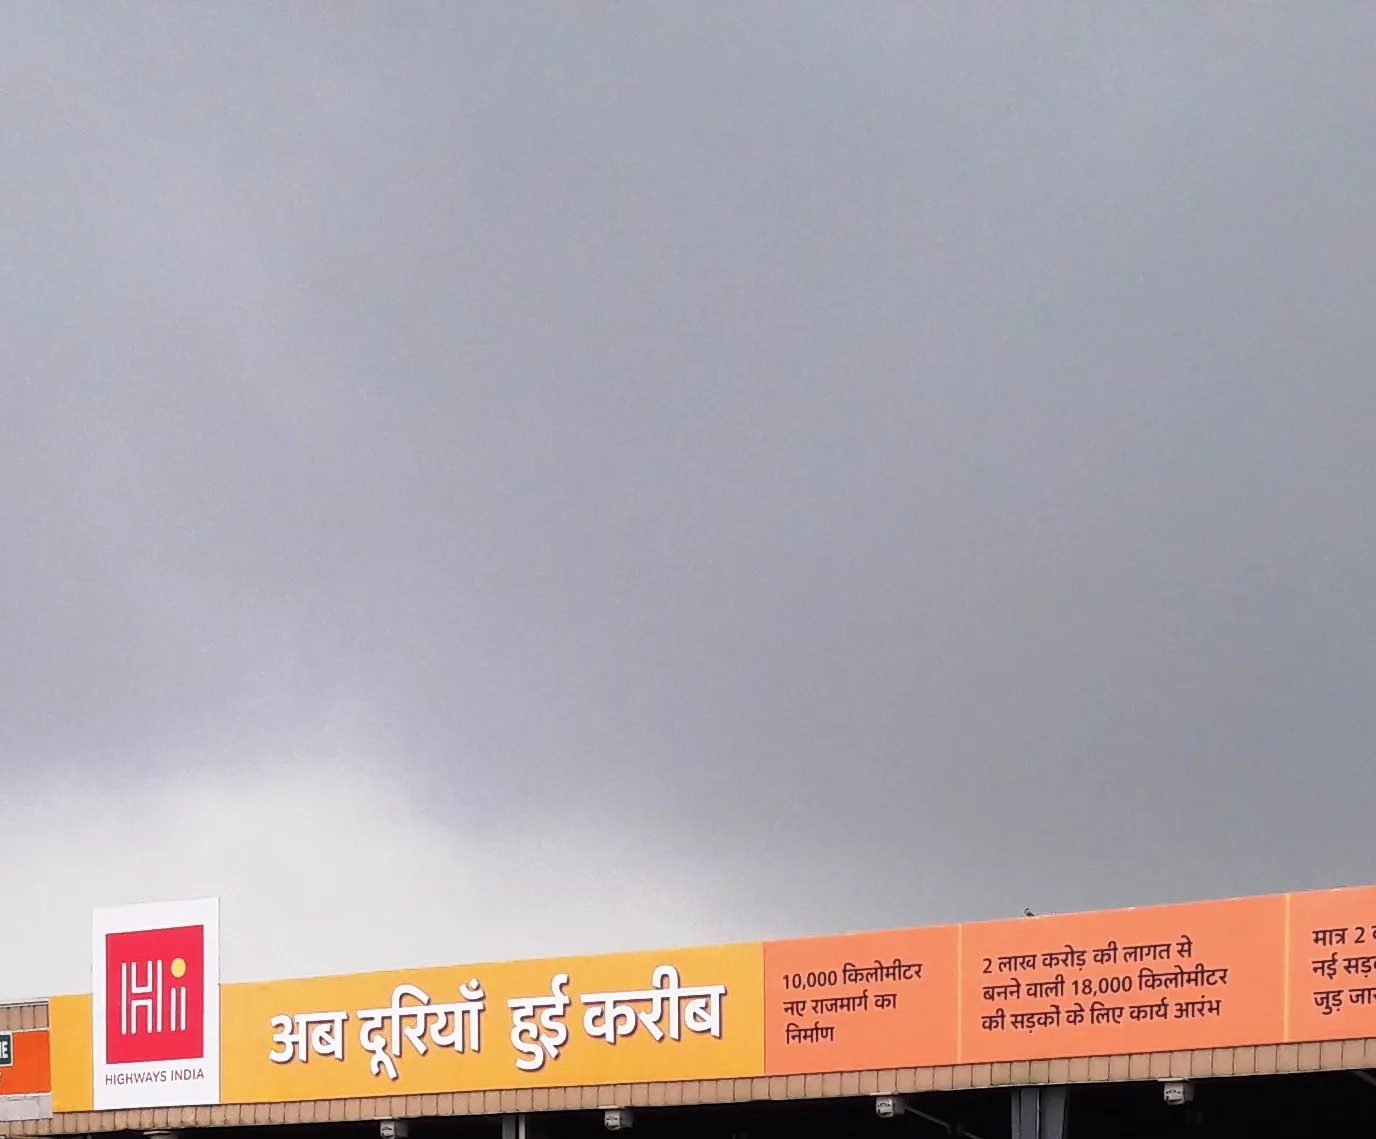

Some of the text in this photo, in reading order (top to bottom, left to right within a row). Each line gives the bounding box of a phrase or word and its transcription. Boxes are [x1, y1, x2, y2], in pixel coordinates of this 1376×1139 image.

[1312, 928, 1348, 946] मात्र
[1354, 927, 1365, 944] 2
[982, 934, 1193, 974] 2 लाख करोड़ की लागत से
[1312, 952, 1338, 980] नई
[783, 958, 923, 990] 10,000 किलोमीटर
[982, 963, 1228, 1002] बनने वाली 18,000 किलोमीटर
[783, 989, 897, 1017] नए राजमार्ग का
[981, 1007, 1006, 1031] की
[1065, 1002, 1085, 1026] के
[1089, 1001, 1125, 1024] लिए
[1129, 996, 1169, 1021] कार्य
[1174, 995, 1222, 1019] आरंभ
[1313, 989, 1344, 1015] जुड़
[269, 965, 726, 1080] अब दूरियाँ हुई करीब
[785, 1021, 835, 1045] निर्माण
[105, 1067, 204, 1086] HIGHWAYS INDIA
